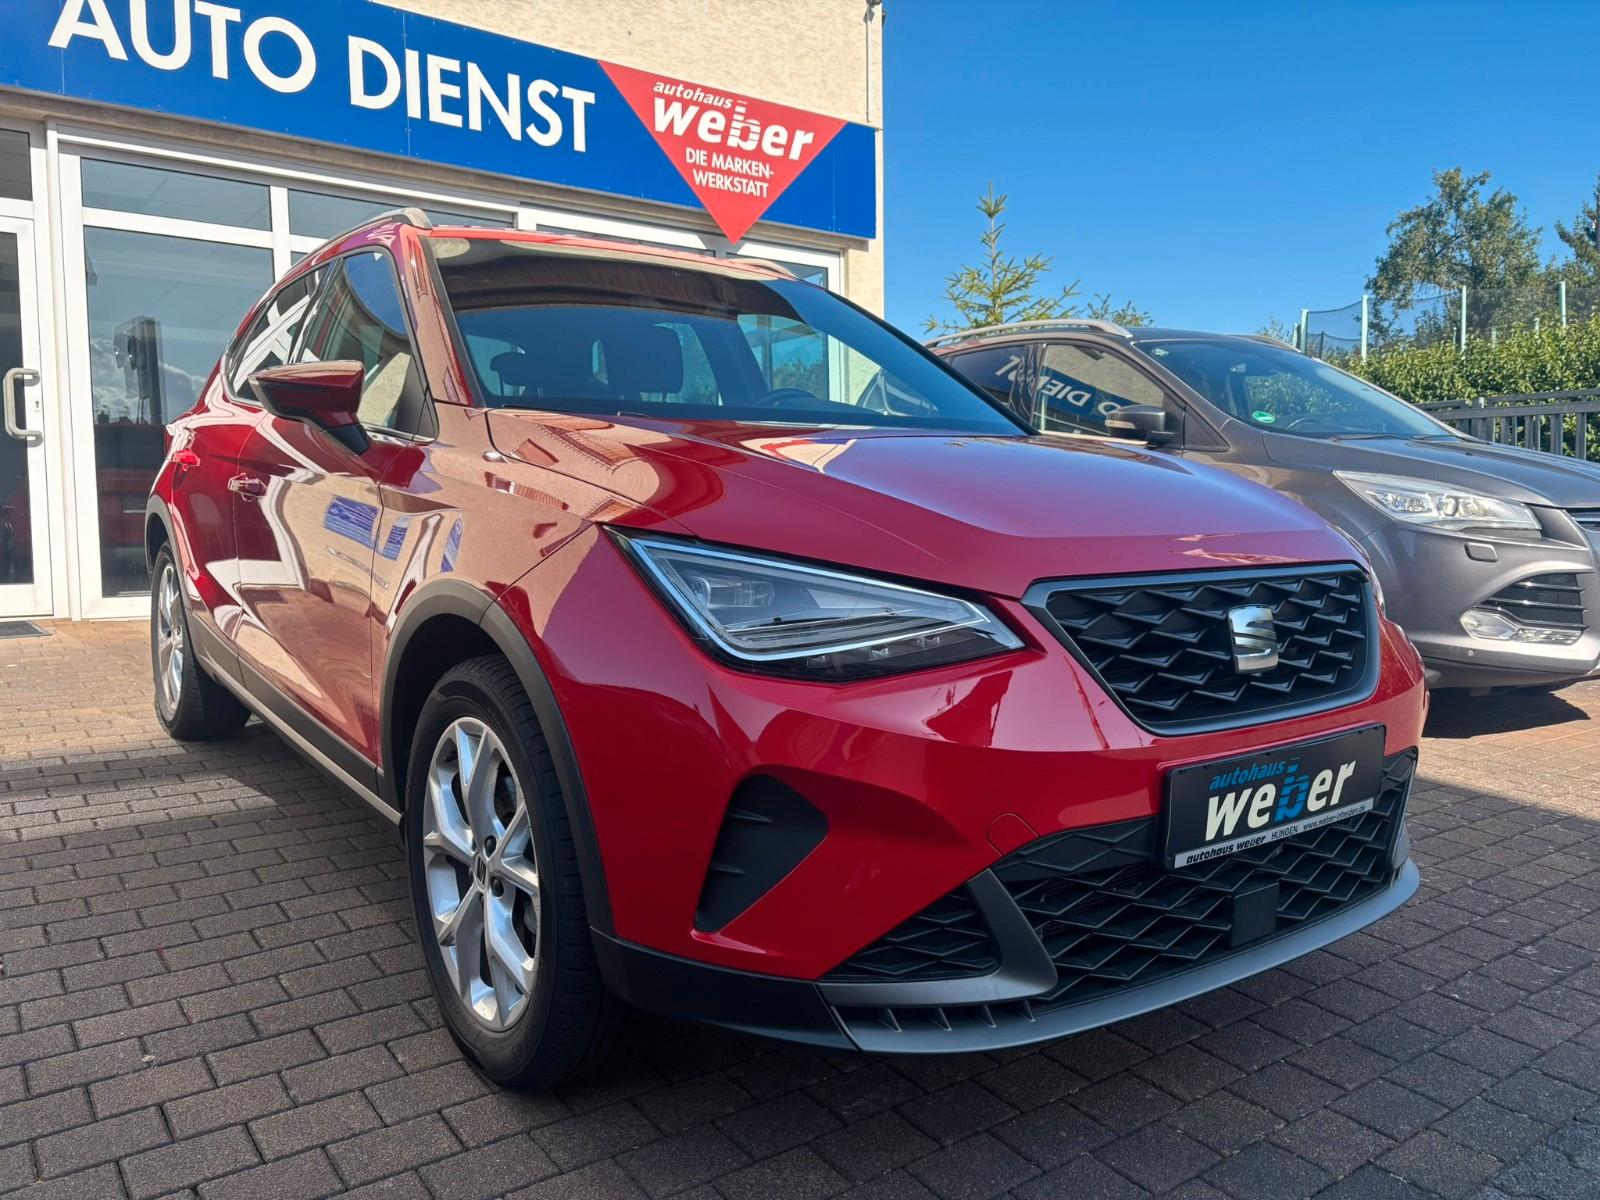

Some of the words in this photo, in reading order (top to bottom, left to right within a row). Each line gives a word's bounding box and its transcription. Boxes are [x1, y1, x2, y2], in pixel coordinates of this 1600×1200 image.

[48, 0, 317, 93] AUTO
[348, 35, 596, 153] DIENST
[653, 81, 733, 109] autohaus
[653, 97, 815, 161] weber
[686, 147, 707, 167] DIE
[711, 155, 775, 179] MARKEN-
[693, 168, 769, 198] WERKSTATT
[1209, 759, 1286, 791] autohaus
[1205, 758, 1356, 841] weber
[1186, 844, 1234, 865] autohaus
[1236, 835, 1266, 851] weber
[1271, 825, 1299, 840] HUNGEN
